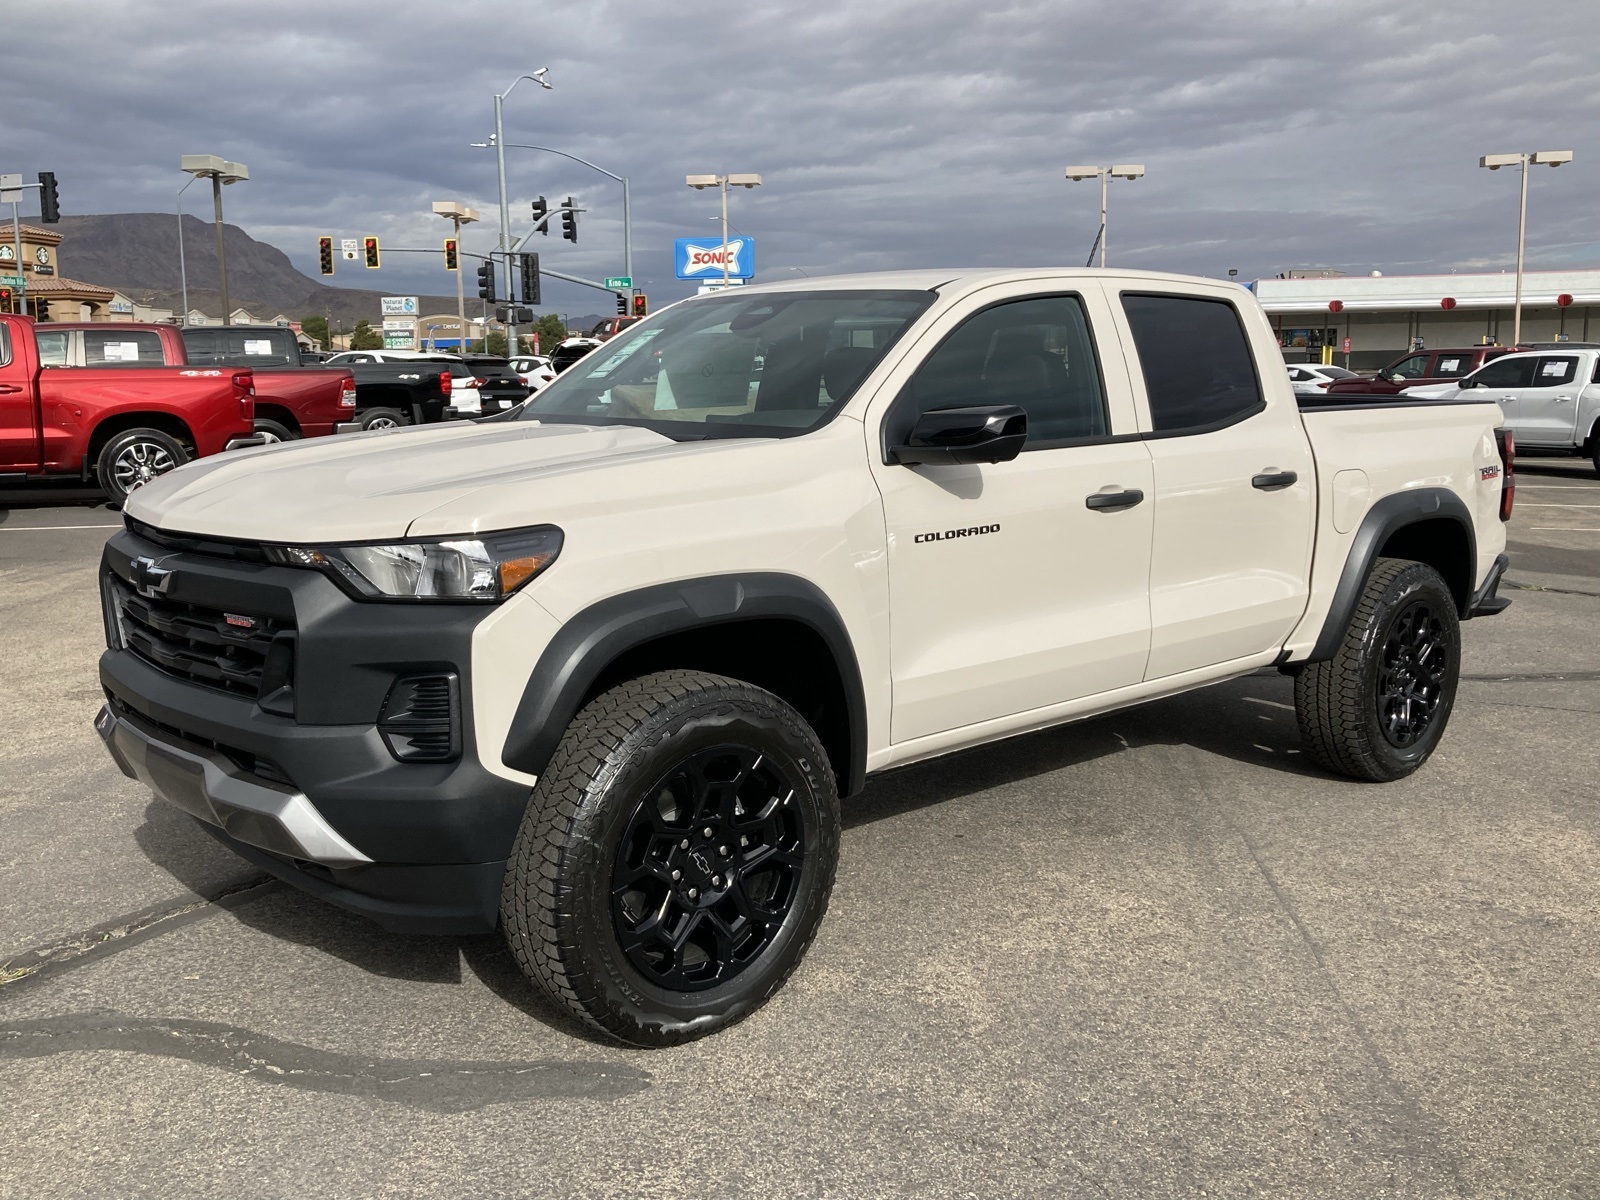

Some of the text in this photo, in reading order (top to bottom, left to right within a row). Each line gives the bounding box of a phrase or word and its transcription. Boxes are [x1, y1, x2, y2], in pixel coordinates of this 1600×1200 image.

[691, 252, 734, 265] SONIC
[608, 279, 622, 287] Kino
[1478, 465, 1502, 475] TRAIL
[914, 523, 1001, 543] COLORADO
